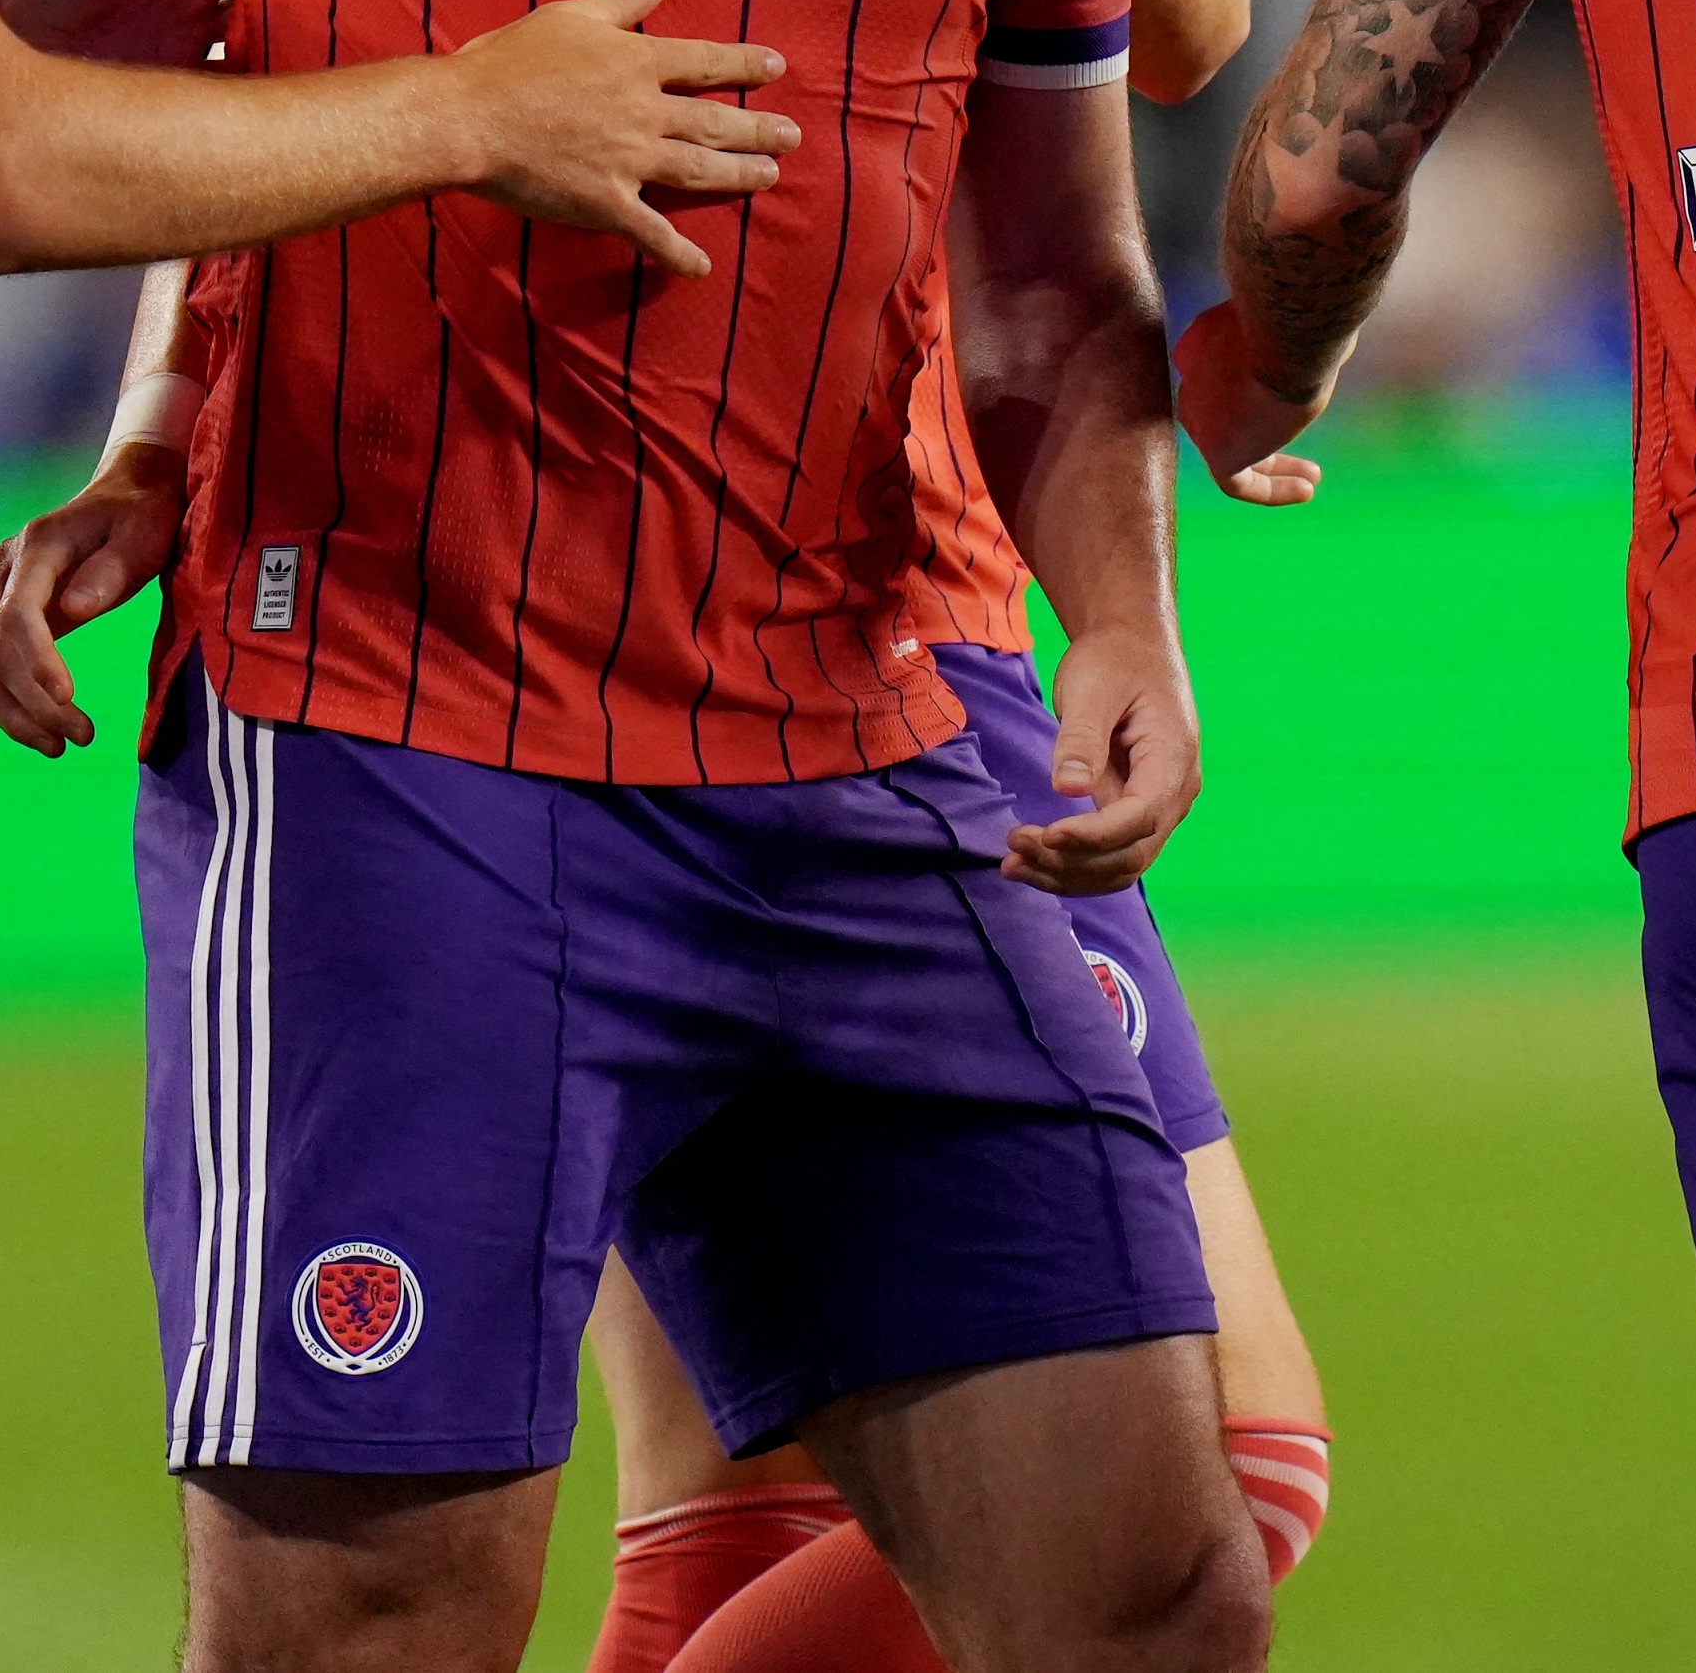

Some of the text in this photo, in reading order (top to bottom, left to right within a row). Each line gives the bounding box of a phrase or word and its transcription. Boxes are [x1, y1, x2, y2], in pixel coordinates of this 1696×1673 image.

[327, 1244, 392, 1263] SCOTLAND
[307, 1342, 404, 1365] EST 1873
